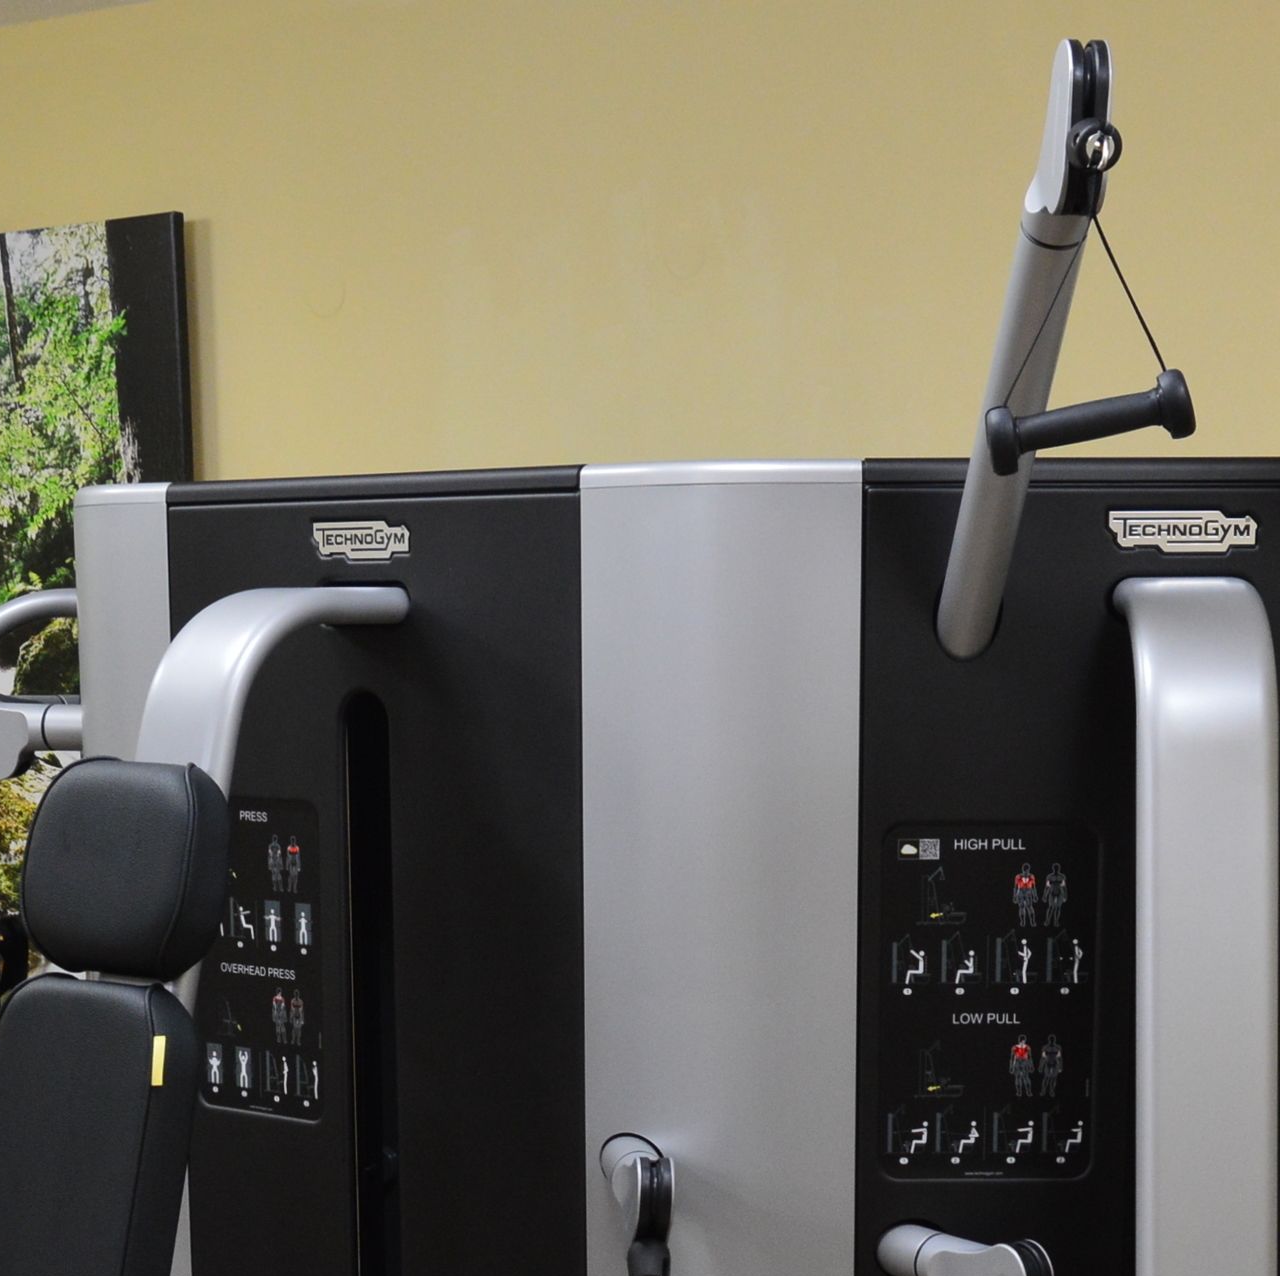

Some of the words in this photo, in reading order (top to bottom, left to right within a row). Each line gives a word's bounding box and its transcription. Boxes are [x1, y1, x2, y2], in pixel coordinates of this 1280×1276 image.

[239, 809, 269, 823] PRESS
[953, 838, 989, 850] HIGH
[991, 838, 1027, 850] PULL
[220, 961, 266, 977] OVERHEAD
[267, 967, 297, 981] PRESS
[952, 1012, 985, 1025] LOW
[986, 1012, 1021, 1025] PULL
